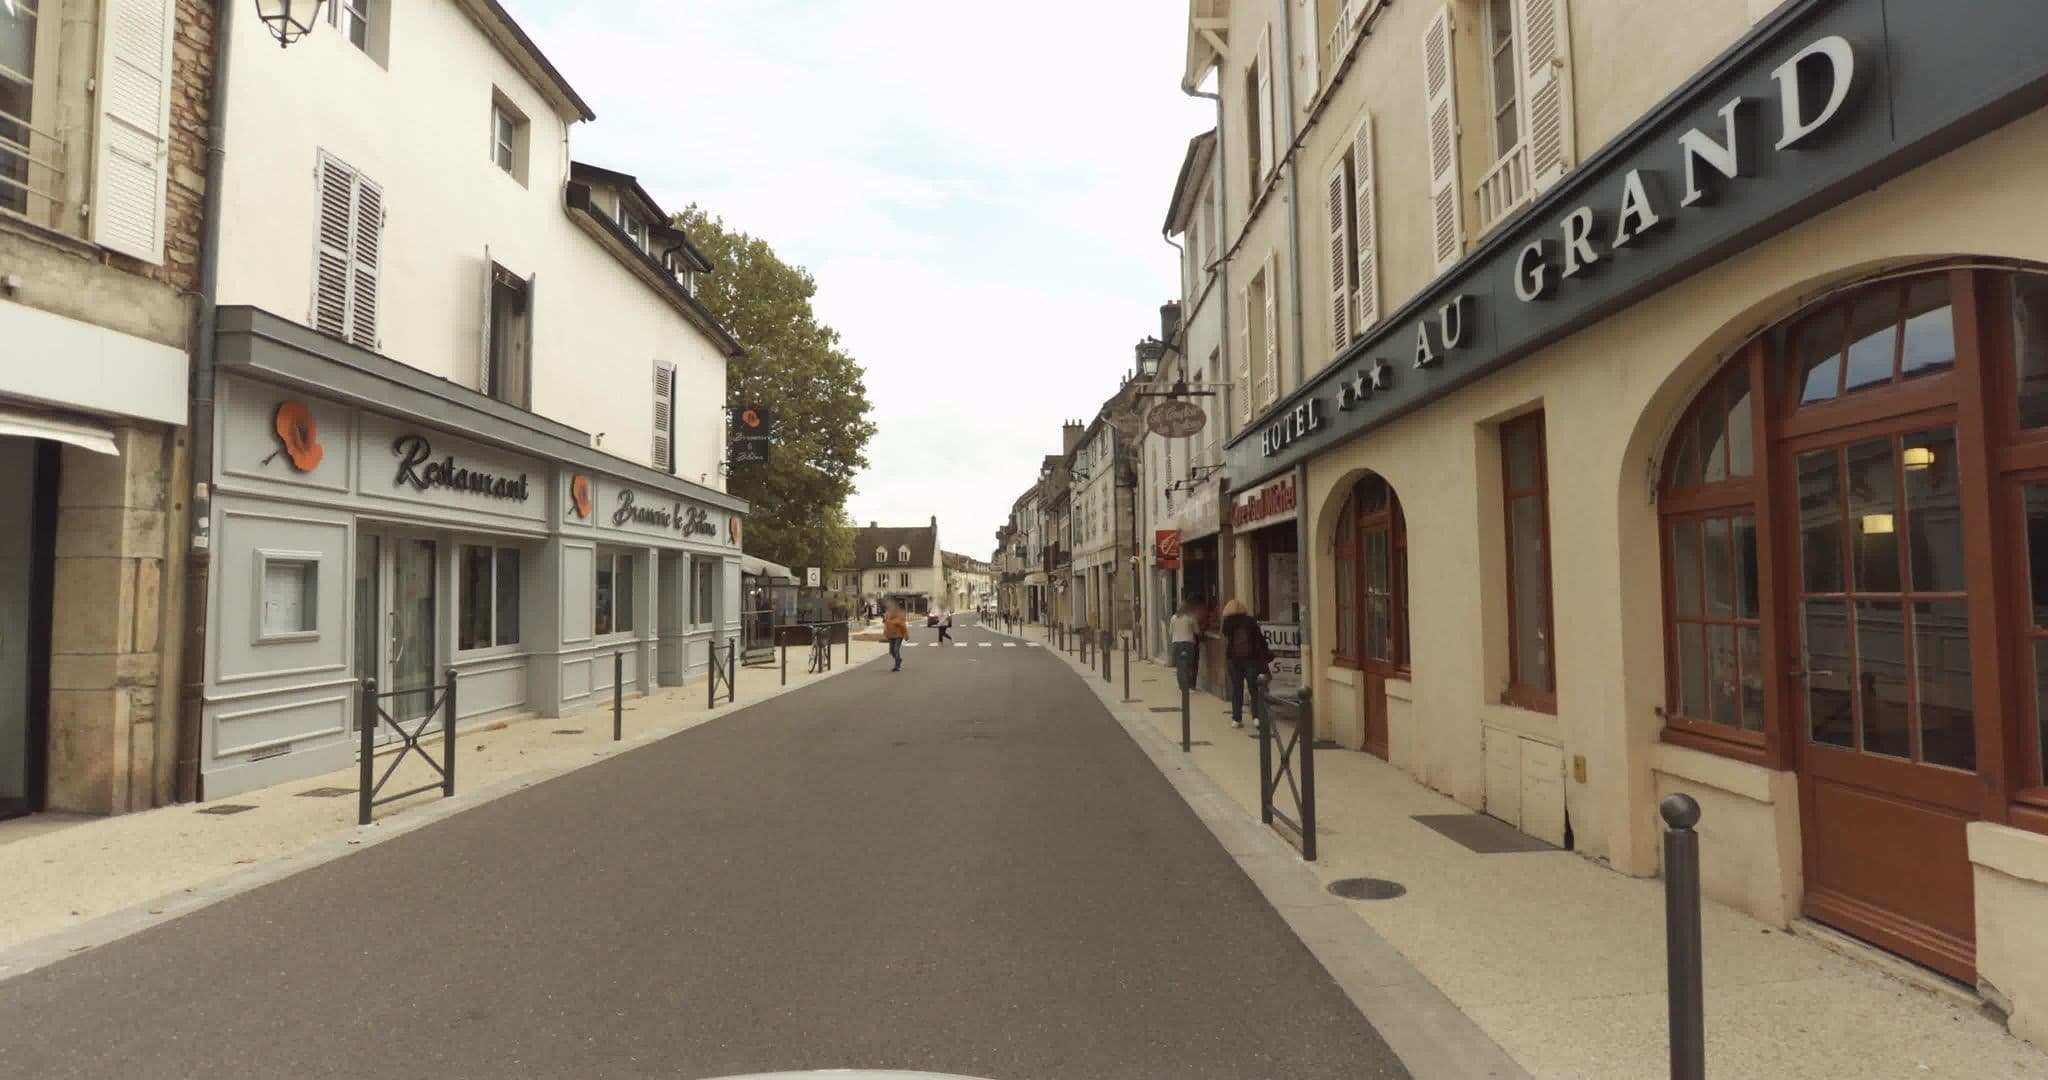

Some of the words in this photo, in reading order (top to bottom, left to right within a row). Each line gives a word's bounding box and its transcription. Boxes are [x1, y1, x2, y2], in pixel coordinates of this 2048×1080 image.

[1261, 398, 1319, 457] HOTEL
[1413, 294, 1465, 369] AU
[1513, 34, 1855, 303] GRAND
[392, 434, 529, 502] Restaurant
[1264, 474, 1297, 517] Michel
[612, 487, 671, 529] Brasserie
